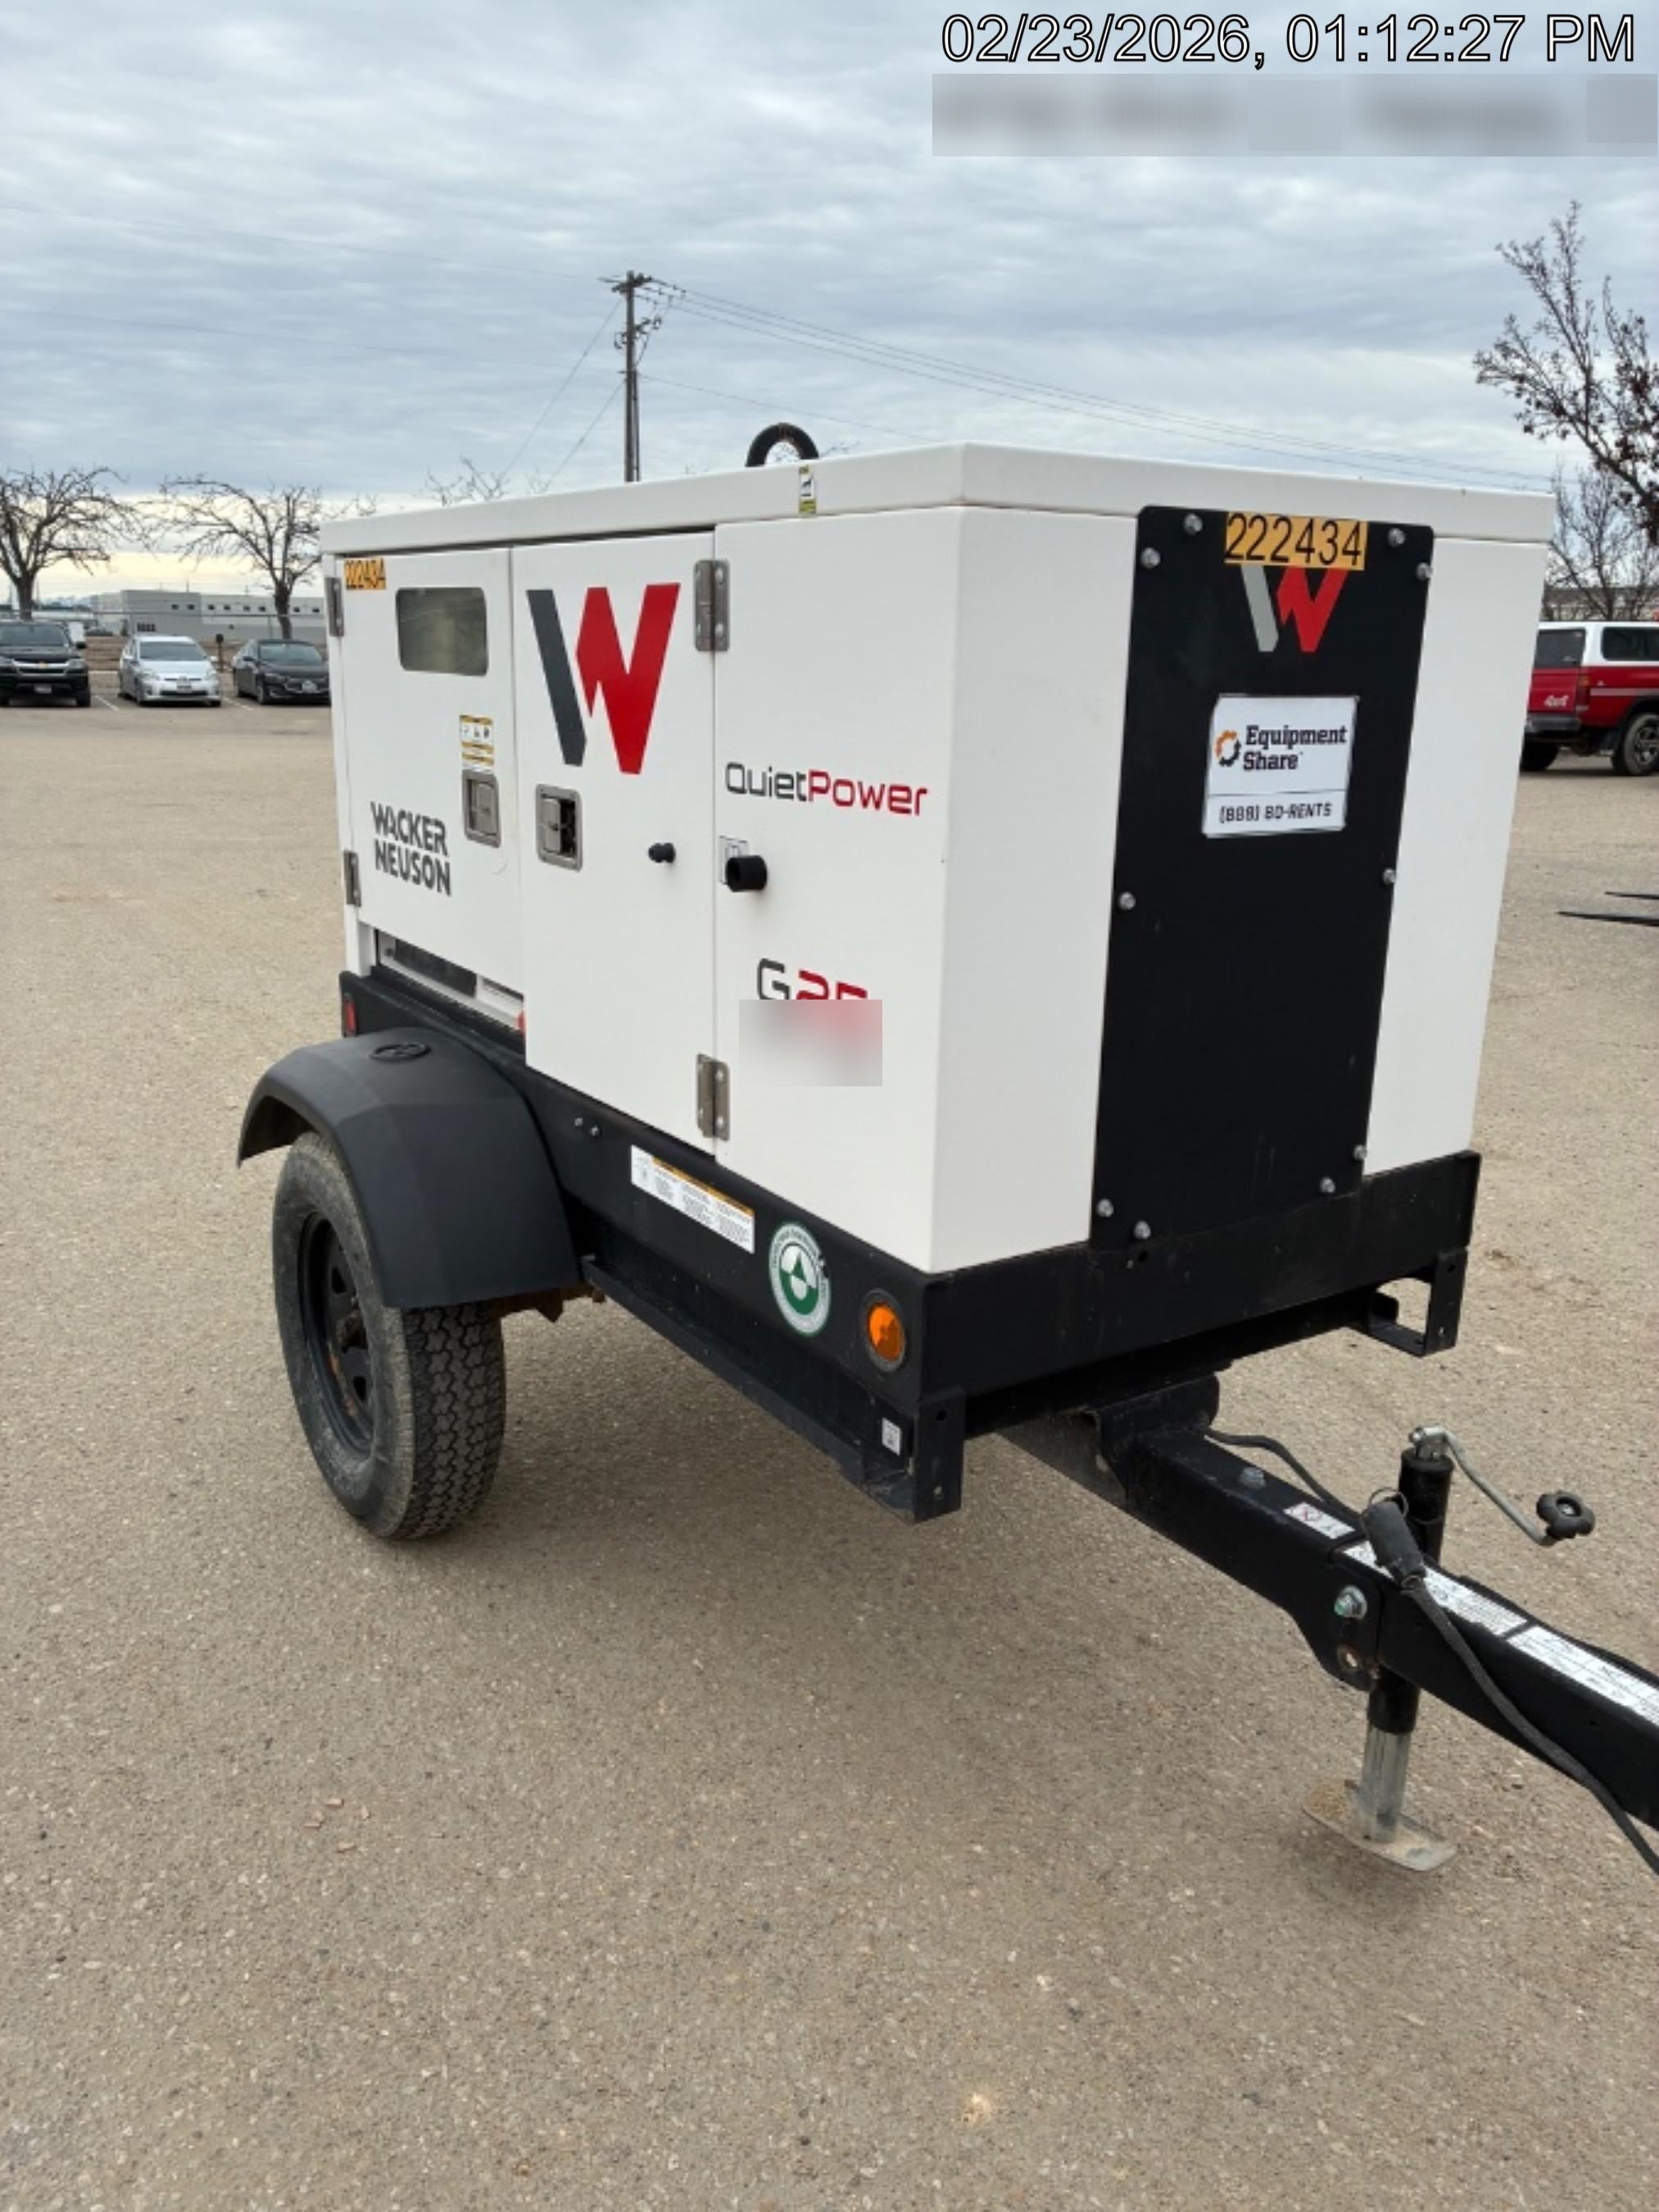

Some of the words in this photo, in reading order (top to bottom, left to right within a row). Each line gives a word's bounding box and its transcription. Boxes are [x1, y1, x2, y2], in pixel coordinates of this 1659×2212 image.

[1225, 513, 1362, 567] 222434
[1243, 751, 1299, 771] Share
[1246, 724, 1348, 750] Equipment
[725, 762, 928, 816] QuietPower
[1219, 805, 1260, 824] (888)
[370, 801, 449, 857] WACKER
[374, 838, 451, 897] NEUSON
